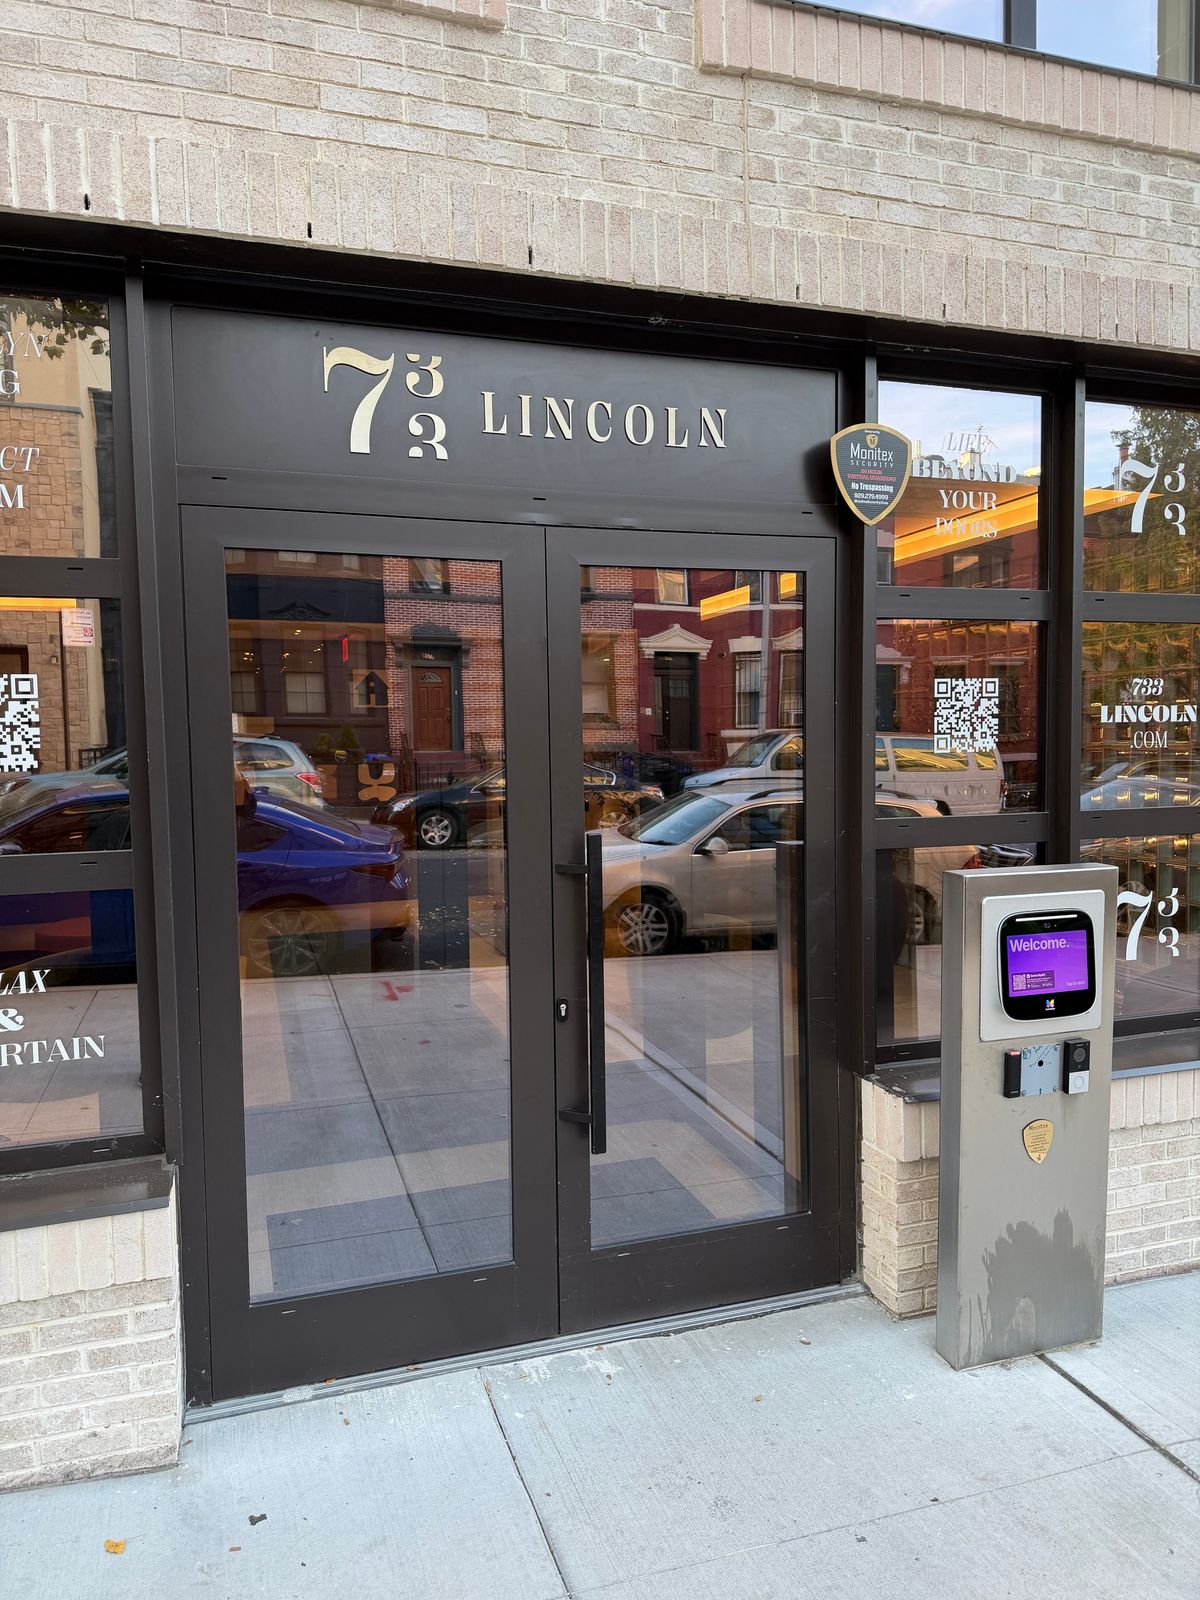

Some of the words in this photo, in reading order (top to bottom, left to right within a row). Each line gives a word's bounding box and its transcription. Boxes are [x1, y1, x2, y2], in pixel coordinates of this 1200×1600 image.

[481, 391, 727, 448] LINCOLN
[850, 442, 894, 462] Monitex
[947, 432, 989, 453] LIFE
[850, 460, 894, 468] SECURITY
[912, 458, 1017, 483] BEYOND
[851, 482, 859, 490] No
[860, 483, 894, 493] Trespassing
[939, 489, 997, 511] YOUR
[936, 517, 998, 538] DOORS
[1132, 677, 1164, 696] 733
[1100, 704, 1198, 723] LINCOLN
[1130, 730, 1168, 748] .COM
[1009, 938, 1070, 952] Welcome.
